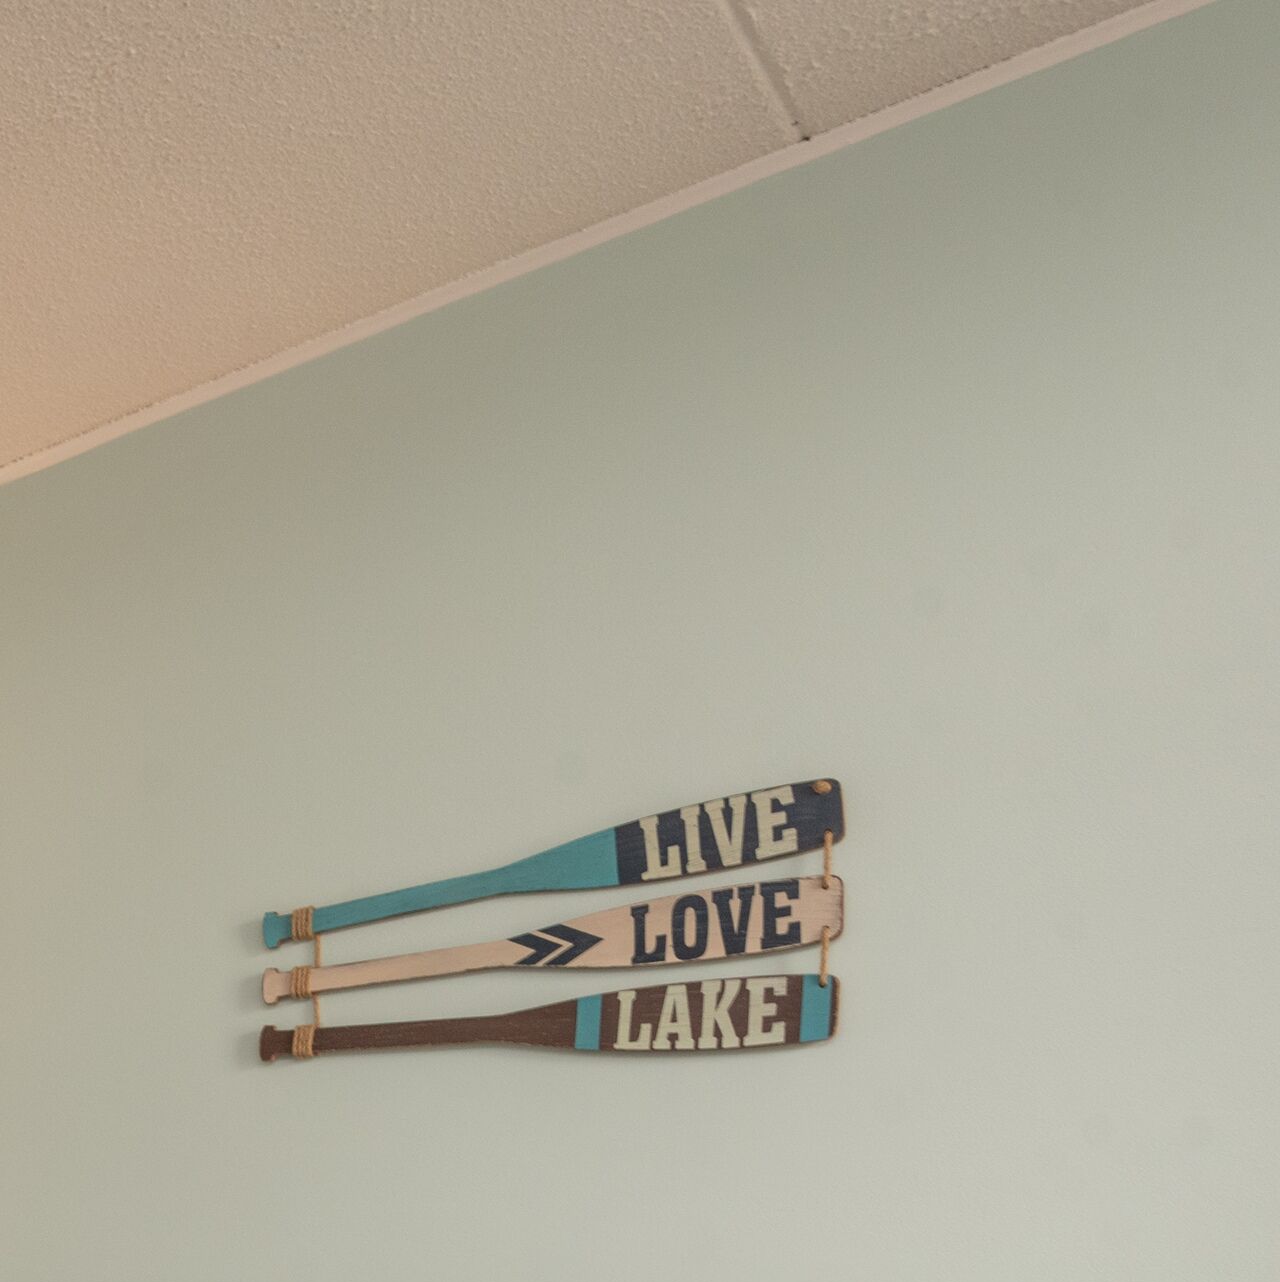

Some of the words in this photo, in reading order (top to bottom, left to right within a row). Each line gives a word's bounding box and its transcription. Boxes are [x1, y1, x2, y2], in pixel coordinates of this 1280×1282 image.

[640, 784, 798, 882] LIVE
[630, 879, 802, 966] LOVE
[612, 976, 789, 1052] LAKE
